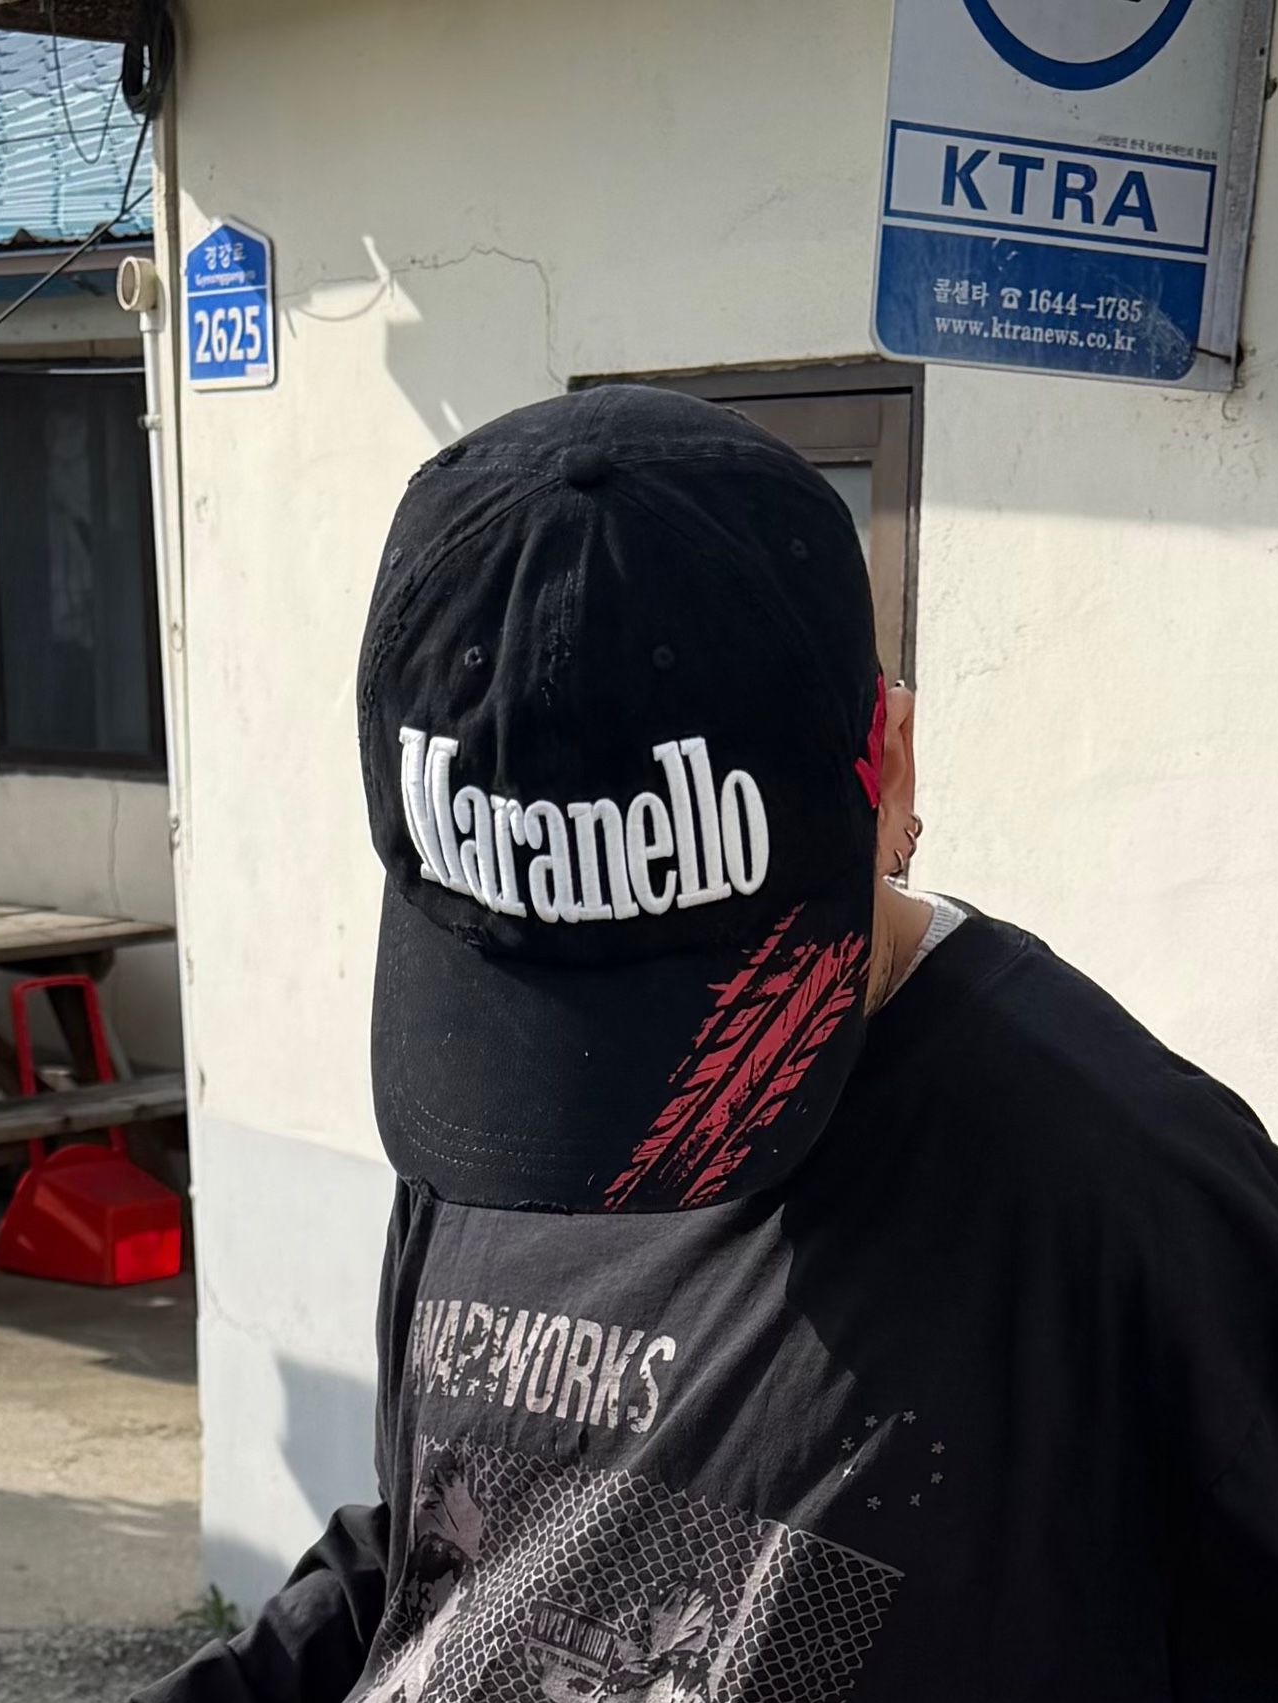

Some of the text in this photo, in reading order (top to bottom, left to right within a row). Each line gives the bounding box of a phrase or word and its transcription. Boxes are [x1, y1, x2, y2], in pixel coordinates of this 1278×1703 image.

[941, 145, 1158, 233] KTRA
[933, 277, 1143, 323] 콜센타 1644-1785
[194, 305, 262, 364] 2625
[934, 315, 1137, 352] www.ktranews.co.kr
[399, 726, 769, 923] Maranello
